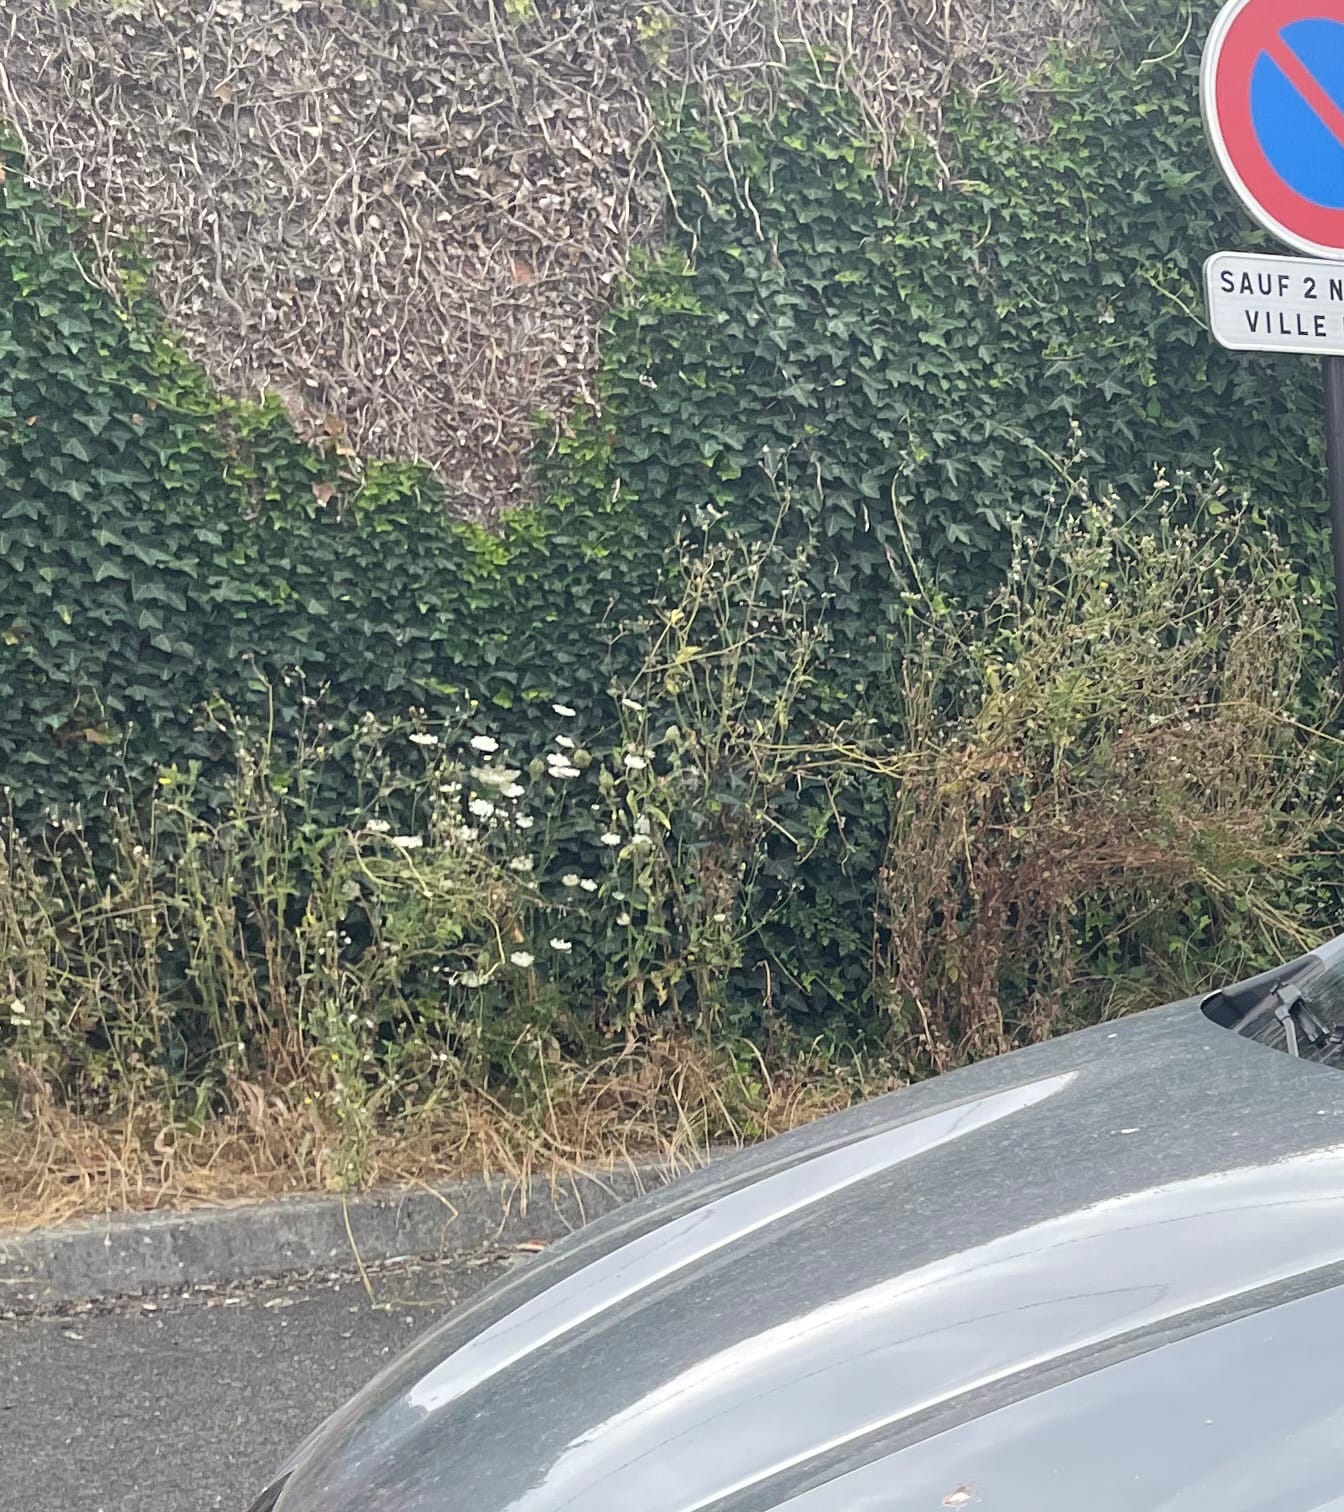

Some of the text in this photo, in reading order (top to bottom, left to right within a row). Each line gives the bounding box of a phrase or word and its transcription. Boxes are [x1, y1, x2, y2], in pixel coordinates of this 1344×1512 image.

[1220, 270, 1290, 297] SAUF
[1303, 276, 1318, 299] 2
[1245, 309, 1327, 338] VILLE
